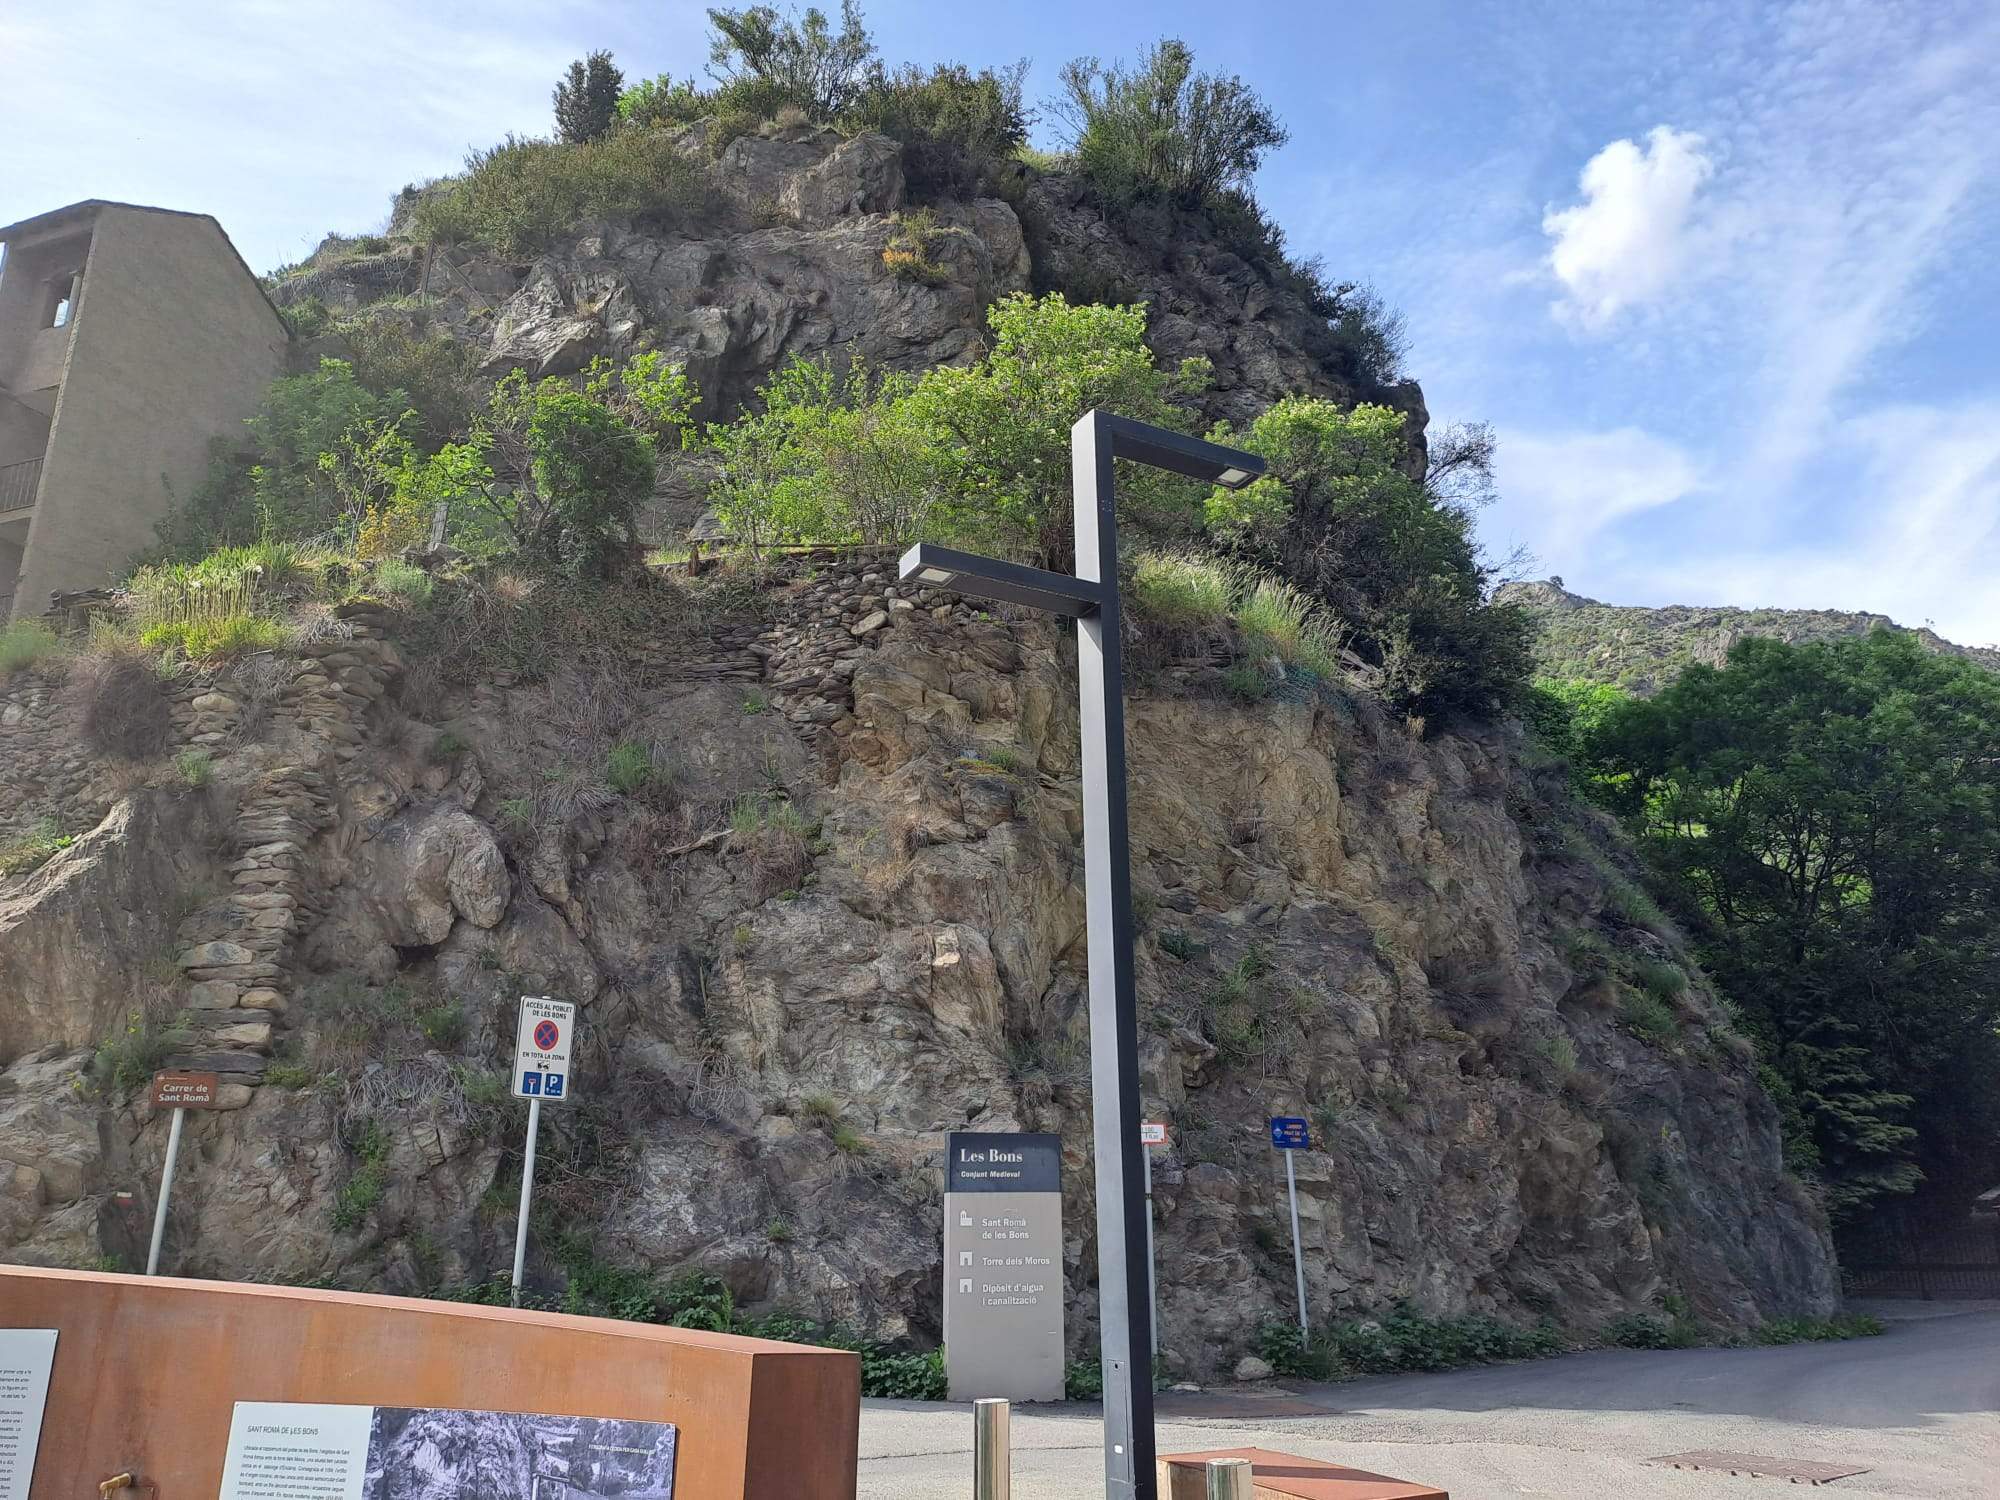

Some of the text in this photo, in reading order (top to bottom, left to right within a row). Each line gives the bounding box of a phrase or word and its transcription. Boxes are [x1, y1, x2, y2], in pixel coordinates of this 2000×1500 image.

[552, 1005, 573, 1013] POBLET
[552, 1012, 567, 1020] BONS
[163, 1084, 208, 1092] Carrer de
[159, 1094, 210, 1102] Sant Romà
[960, 1149, 1024, 1163] Les Bons
[961, 1171, 988, 1179] Conjunt
[982, 1219, 1026, 1227] Sant Romà
[982, 1231, 1030, 1239] de les Bons
[982, 1257, 1050, 1266] Torre dels Moros
[982, 1284, 1044, 1294] Dipòsit d'aigua
[988, 1297, 1037, 1306] canalització
[263, 1425, 280, 1433] ROMÀ
[290, 1427, 302, 1435] LES
